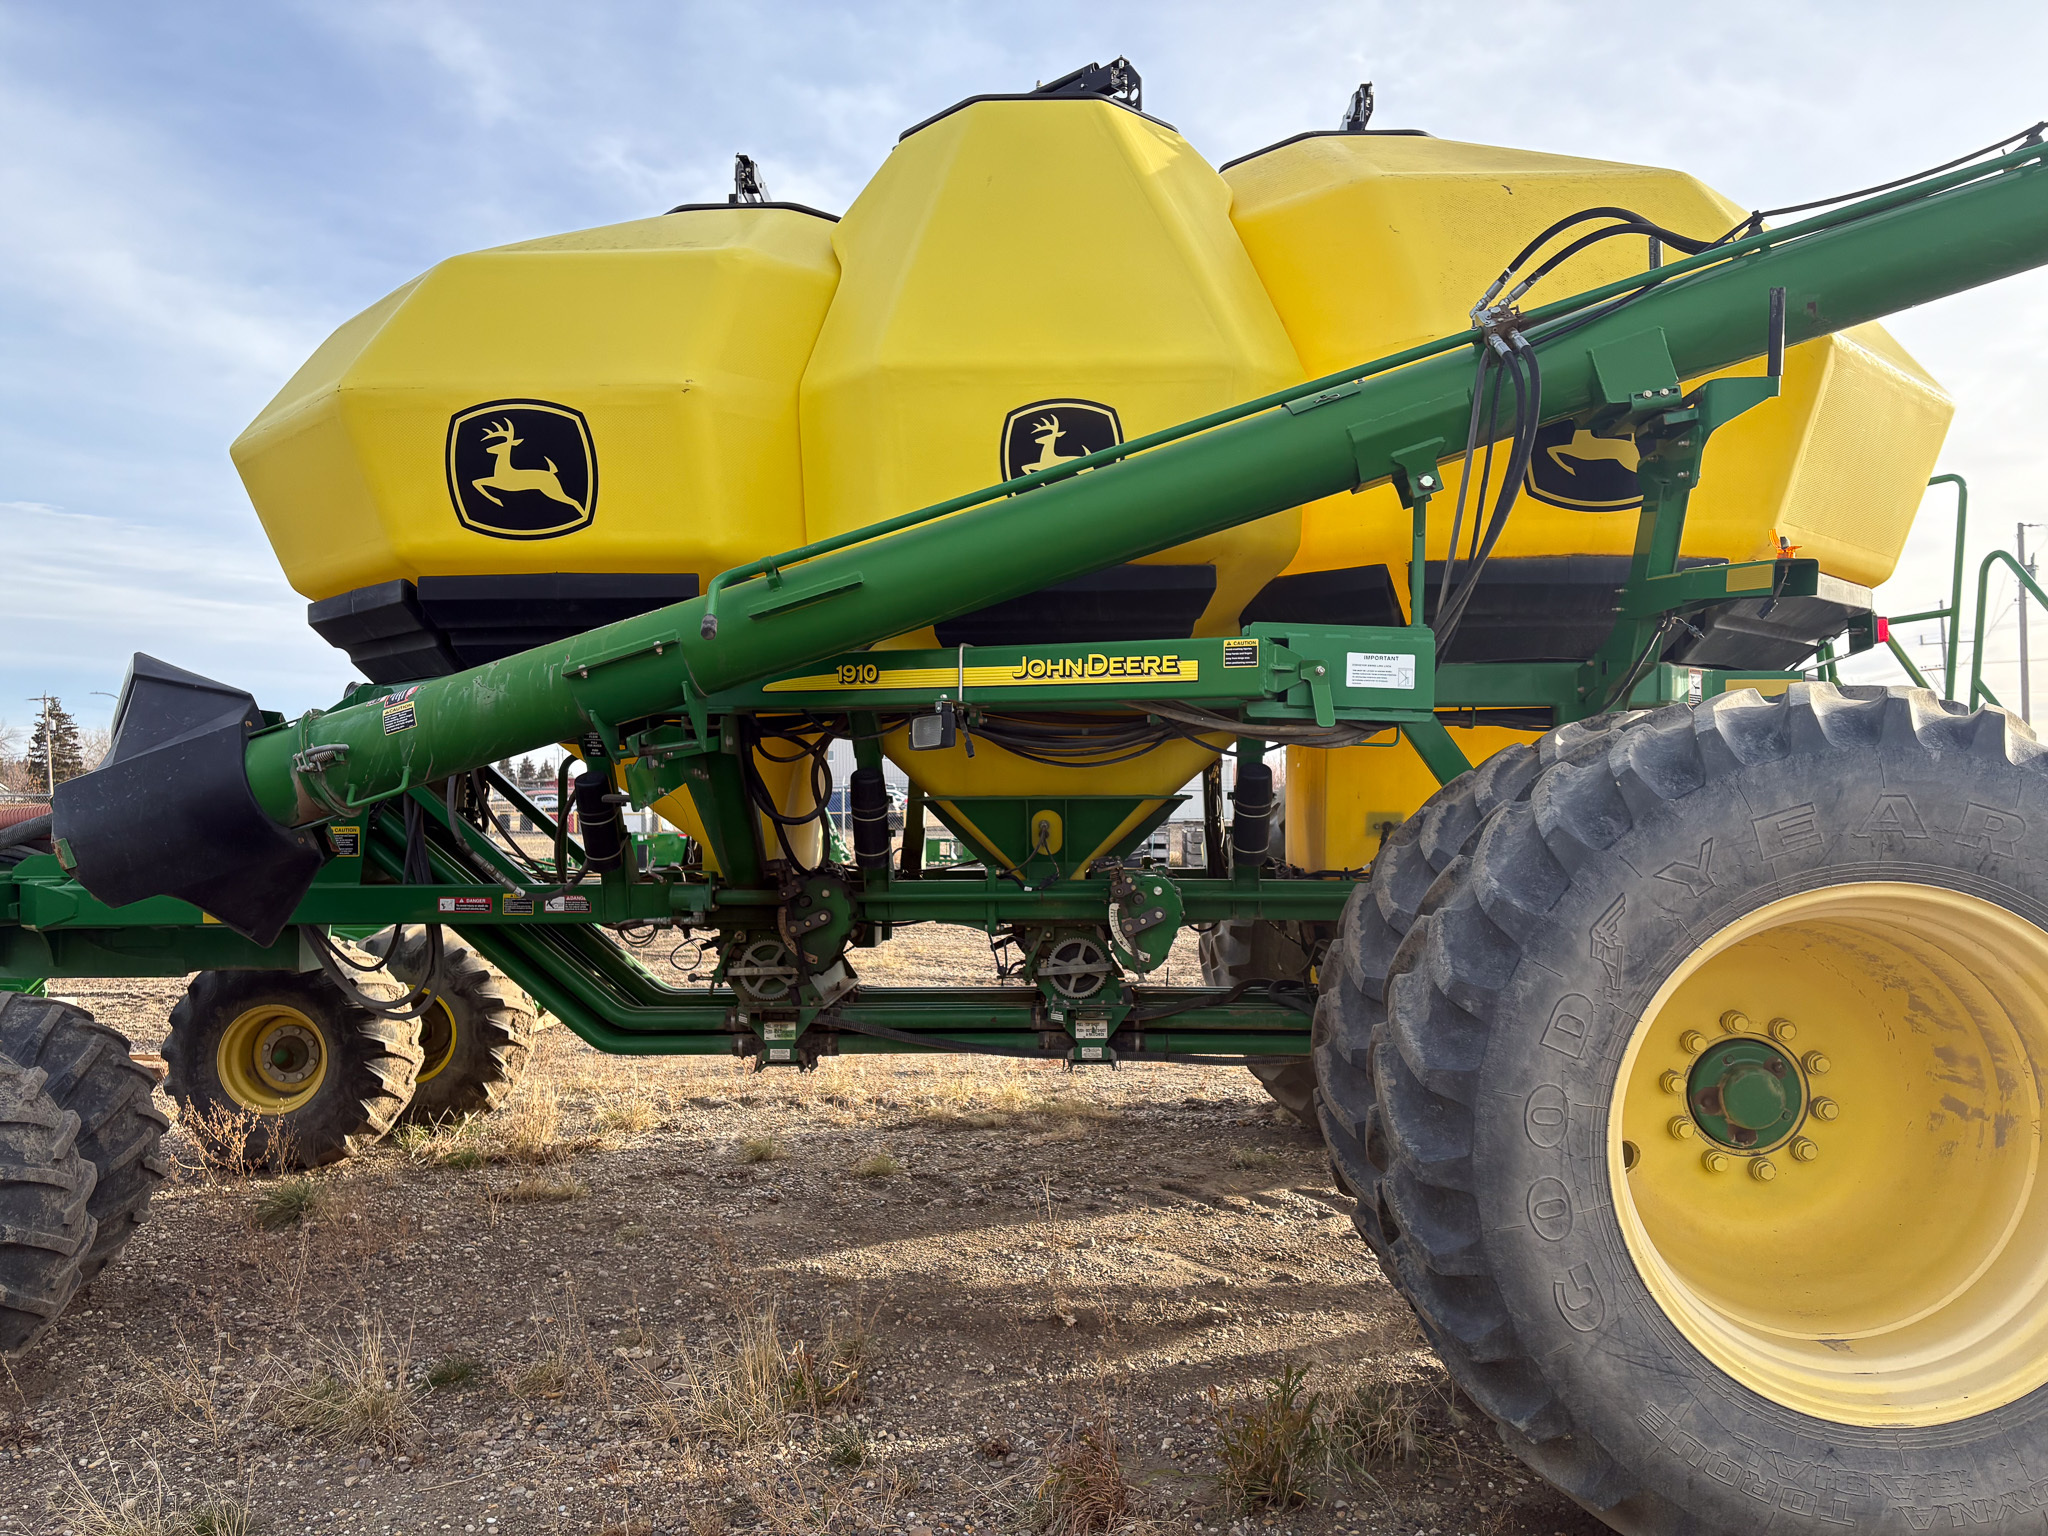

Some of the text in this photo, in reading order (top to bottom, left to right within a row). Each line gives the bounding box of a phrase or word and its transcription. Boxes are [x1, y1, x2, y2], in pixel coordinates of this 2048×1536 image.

[836, 664, 879, 684] 1910
[1012, 653, 1181, 679] JOHN DEERE
[390, 703, 413, 714] CAUTION
[1636, 1401, 1856, 1528] TORQUE
[1728, 1430, 1970, 1501] RADIAL
